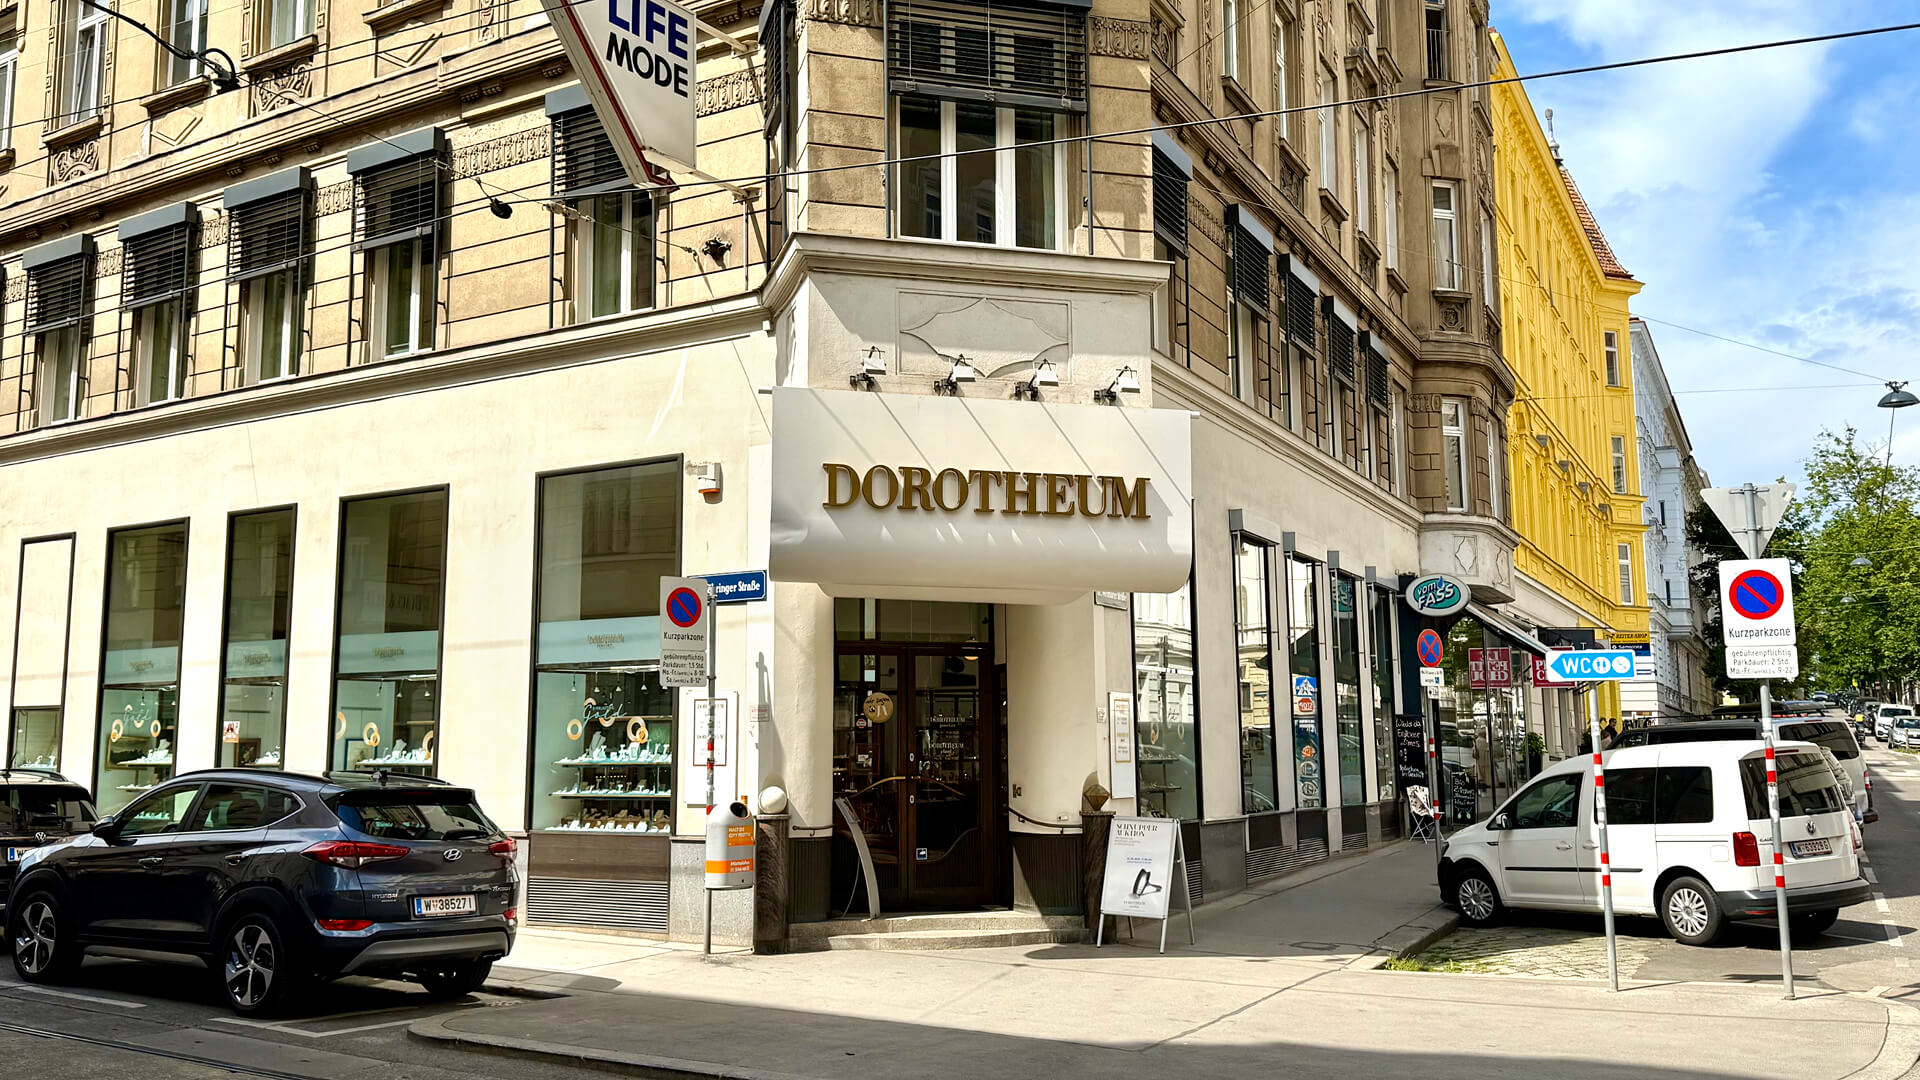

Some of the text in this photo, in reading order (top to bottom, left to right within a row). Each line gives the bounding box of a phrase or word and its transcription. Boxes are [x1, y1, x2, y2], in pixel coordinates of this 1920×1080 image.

[608, 0, 689, 60] LIFE
[606, 31, 689, 98] MODE
[822, 463, 1152, 519] DOROTHEUM
[738, 580, 760, 592] Straße
[1416, 582, 1436, 594] vom
[1418, 584, 1455, 610] FASS
[663, 632, 704, 642] Kurzparkzone
[1728, 627, 1791, 640] Kurzparkzone
[1562, 658, 1592, 674] WC
